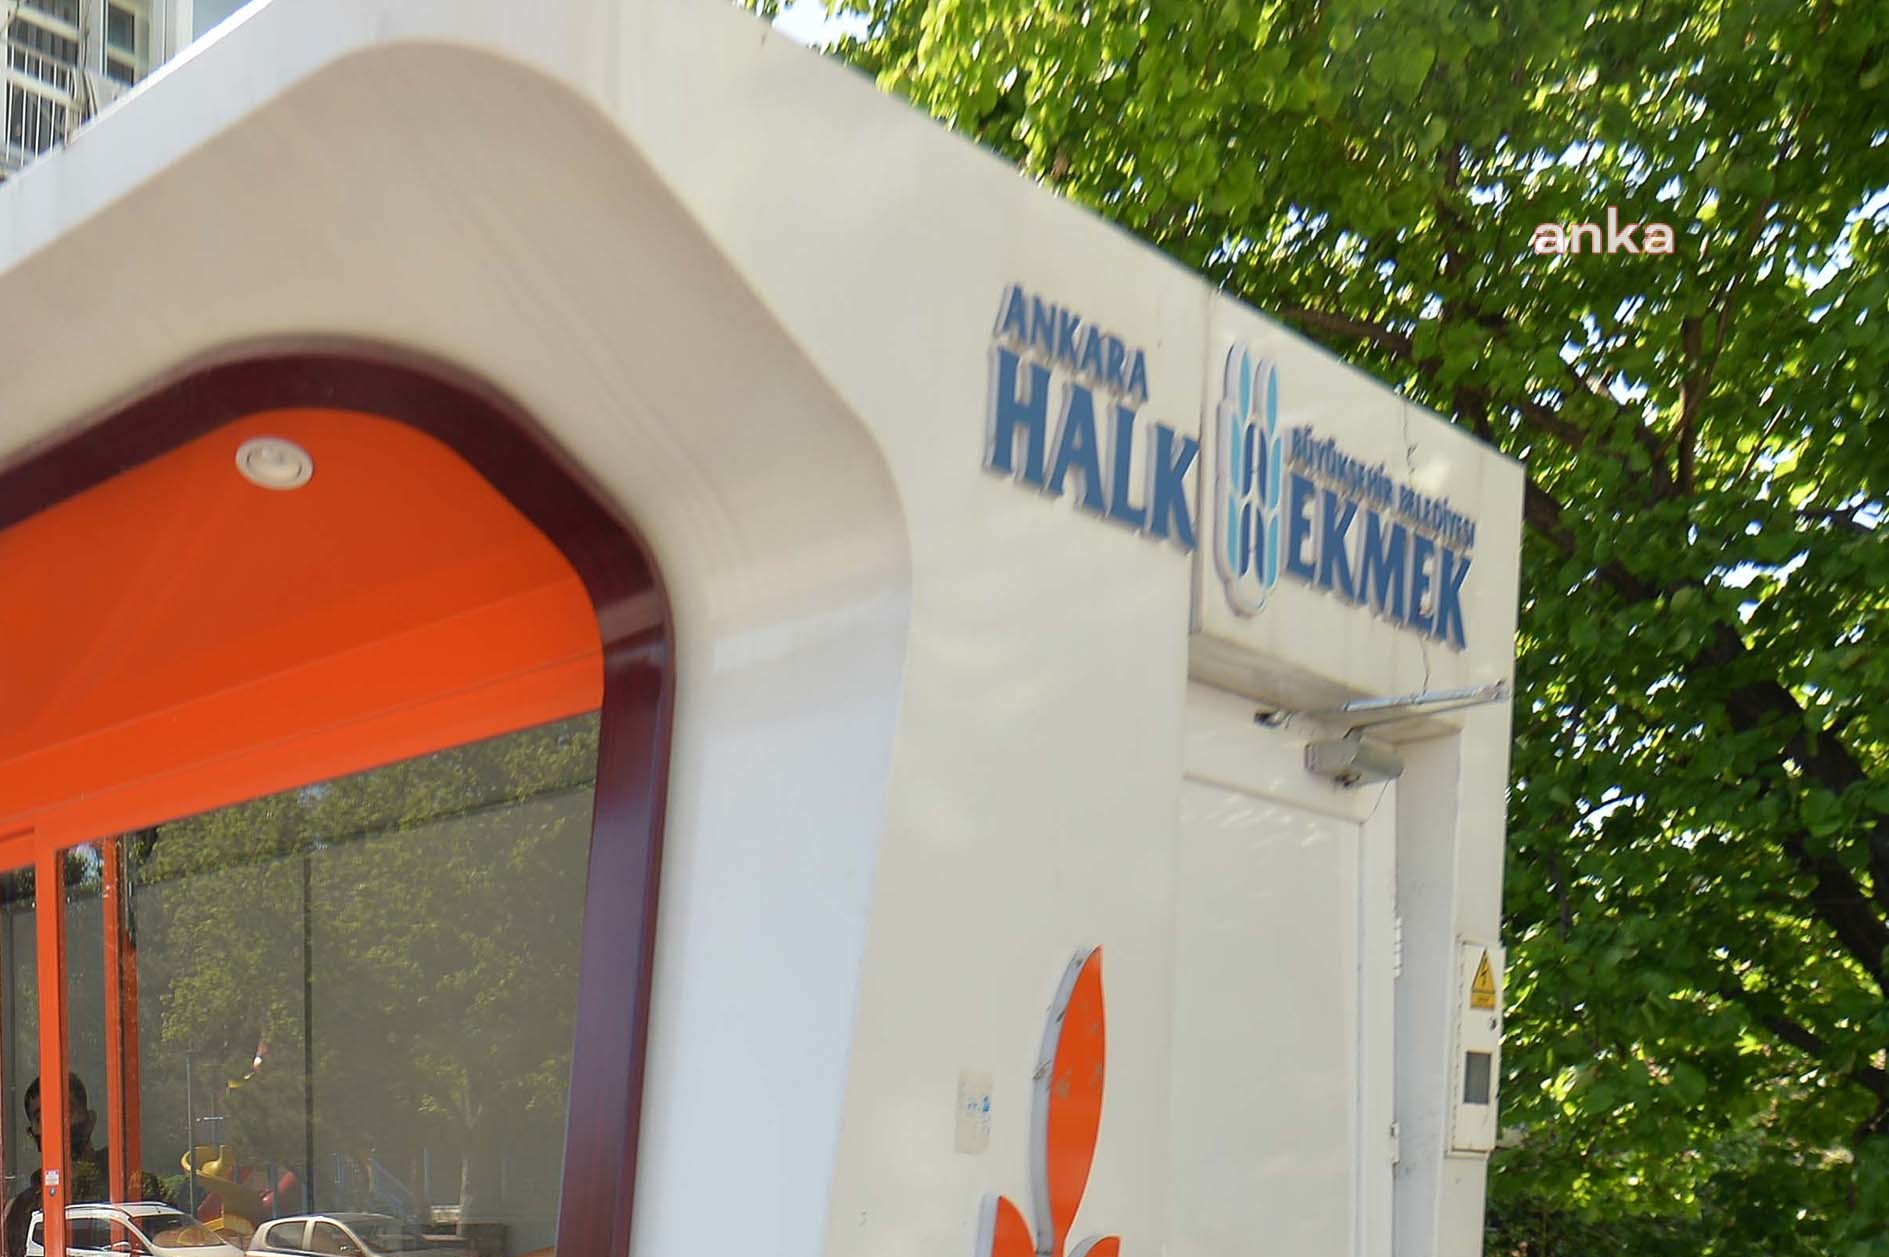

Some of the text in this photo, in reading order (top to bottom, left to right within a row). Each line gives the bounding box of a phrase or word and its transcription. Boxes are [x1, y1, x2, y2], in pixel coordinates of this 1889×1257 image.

[994, 284, 1148, 402] ANKARA
[986, 346, 1201, 553] HALK
[1286, 470, 1472, 650] EKMEK
